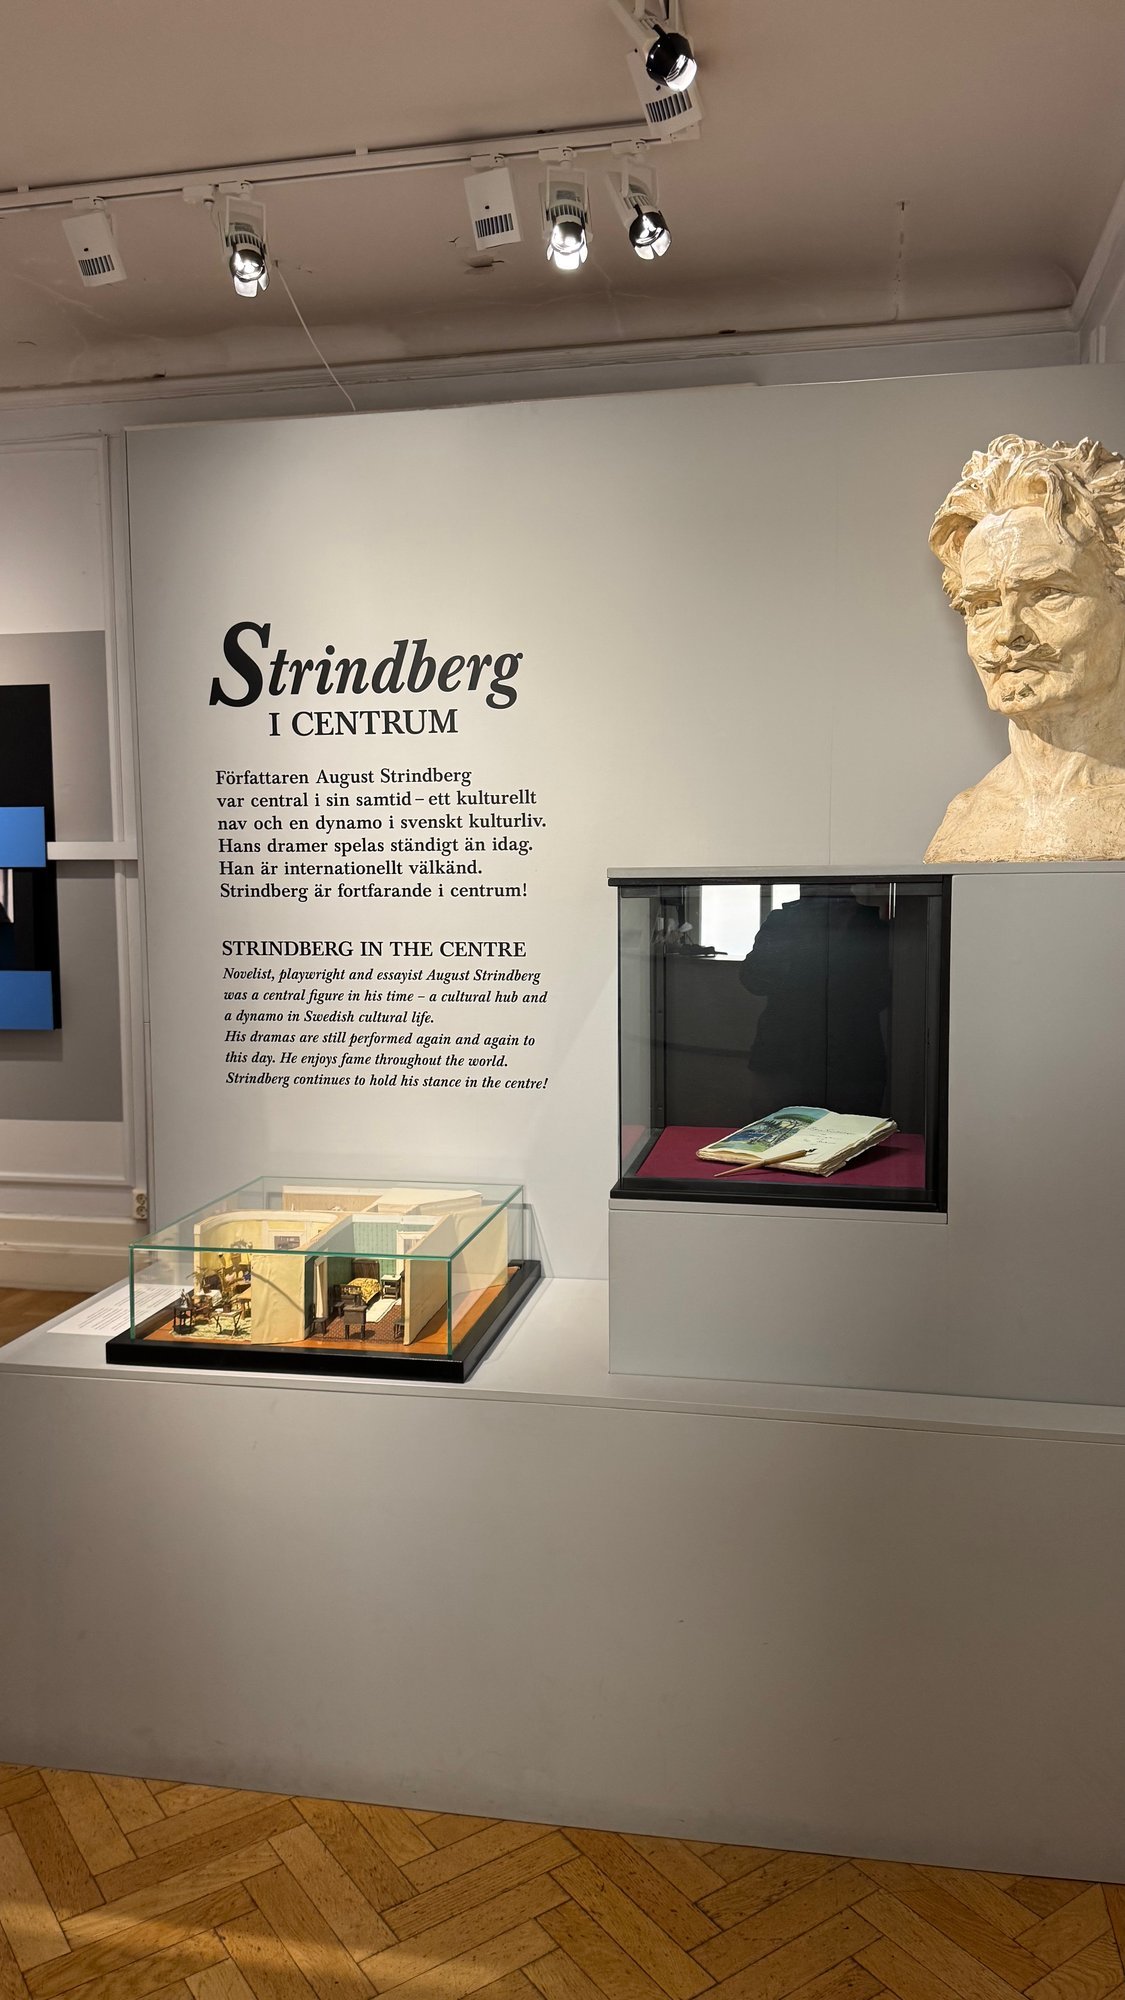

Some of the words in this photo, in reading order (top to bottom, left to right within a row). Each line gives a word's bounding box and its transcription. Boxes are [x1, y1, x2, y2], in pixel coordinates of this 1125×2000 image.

[208, 621, 524, 710] Strindberg
[268, 712, 281, 737] I
[291, 708, 459, 737] CENTRUM
[215, 769, 310, 785] Författaren
[315, 768, 375, 789] August
[380, 767, 472, 788] Strindberg
[216, 797, 245, 808] var
[250, 791, 309, 808] central
[314, 792, 321, 807] i
[326, 792, 351, 807] sin
[355, 790, 412, 807] samtid
[428, 792, 451, 806] ett
[456, 788, 537, 806] kulturellt
[217, 819, 248, 831] nav
[253, 815, 283, 831] och
[289, 819, 310, 830] en
[315, 814, 383, 835] dynamo
[388, 814, 395, 830] i
[400, 813, 464, 829] svenskt
[468, 812, 547, 829] kulturliv.
[217, 838, 261, 853] Hans
[267, 837, 329, 853] dramer
[334, 837, 385, 858] spelas
[390, 836, 460, 857] ständigt
[464, 837, 486, 852] än
[491, 835, 533, 856] idag.
[218, 860, 255, 876] Han
[260, 861, 279, 876] är
[283, 859, 404, 876] internationellt
[408, 859, 483, 875] välkänd.
[220, 882, 309, 903] Strindberg
[314, 883, 333, 898] är
[337, 882, 432, 898] fortfarande
[438, 883, 444, 898] i
[450, 882, 527, 898] centrum!
[222, 940, 354, 957] STRINDBERG
[359, 941, 384, 957] IN
[389, 941, 434, 957] THE
[439, 940, 527, 958] CENTRE
[222, 967, 275, 982] Novelist,
[277, 967, 346, 984] playwright
[348, 967, 374, 981] and
[376, 968, 423, 985] essayist
[425, 968, 471, 985] August
[472, 968, 542, 986] Strindberg
[223, 991, 248, 1001] was
[251, 991, 260, 1001] a
[262, 988, 306, 1001] central
[305, 988, 345, 1005] figure
[347, 989, 361, 1002] in
[364, 989, 383, 1002] his
[386, 990, 415, 1002] time
[428, 993, 437, 1003] a
[440, 989, 492, 1003] cultural
[494, 990, 519, 1003] hub
[522, 990, 549, 1004] and
[224, 1012, 233, 1022] a
[235, 1009, 284, 1025] dynamo
[287, 1010, 301, 1022] in
[303, 1009, 355, 1023] Swedish
[358, 1010, 408, 1023] cultural
[411, 1010, 434, 1028] life.
[224, 1030, 247, 1043] His
[249, 1030, 296, 1043] dramas
[299, 1034, 320, 1044] are
[321, 1031, 347, 1044] still
[347, 1031, 414, 1048] performed
[415, 1033, 452, 1049] again
[455, 1033, 481, 1046] and
[483, 1034, 520, 1050] again
[523, 1035, 536, 1047] to
[225, 1050, 249, 1063] this
[250, 1051, 276, 1067] day.
[279, 1051, 298, 1064] He
[300, 1052, 338, 1068] enjoys
[337, 1052, 372, 1069] fame
[374, 1052, 443, 1070] throughout
[445, 1053, 465, 1067] the
[468, 1054, 508, 1067] world.
[225, 1071, 291, 1089] Strindberg
[293, 1073, 351, 1086] continues
[354, 1074, 366, 1086] to
[369, 1073, 398, 1087] hold
[400, 1074, 420, 1087] his
[422, 1076, 462, 1088] stance
[465, 1076, 478, 1088] in
[481, 1075, 502, 1089] the
[504, 1077, 549, 1090] centre!
